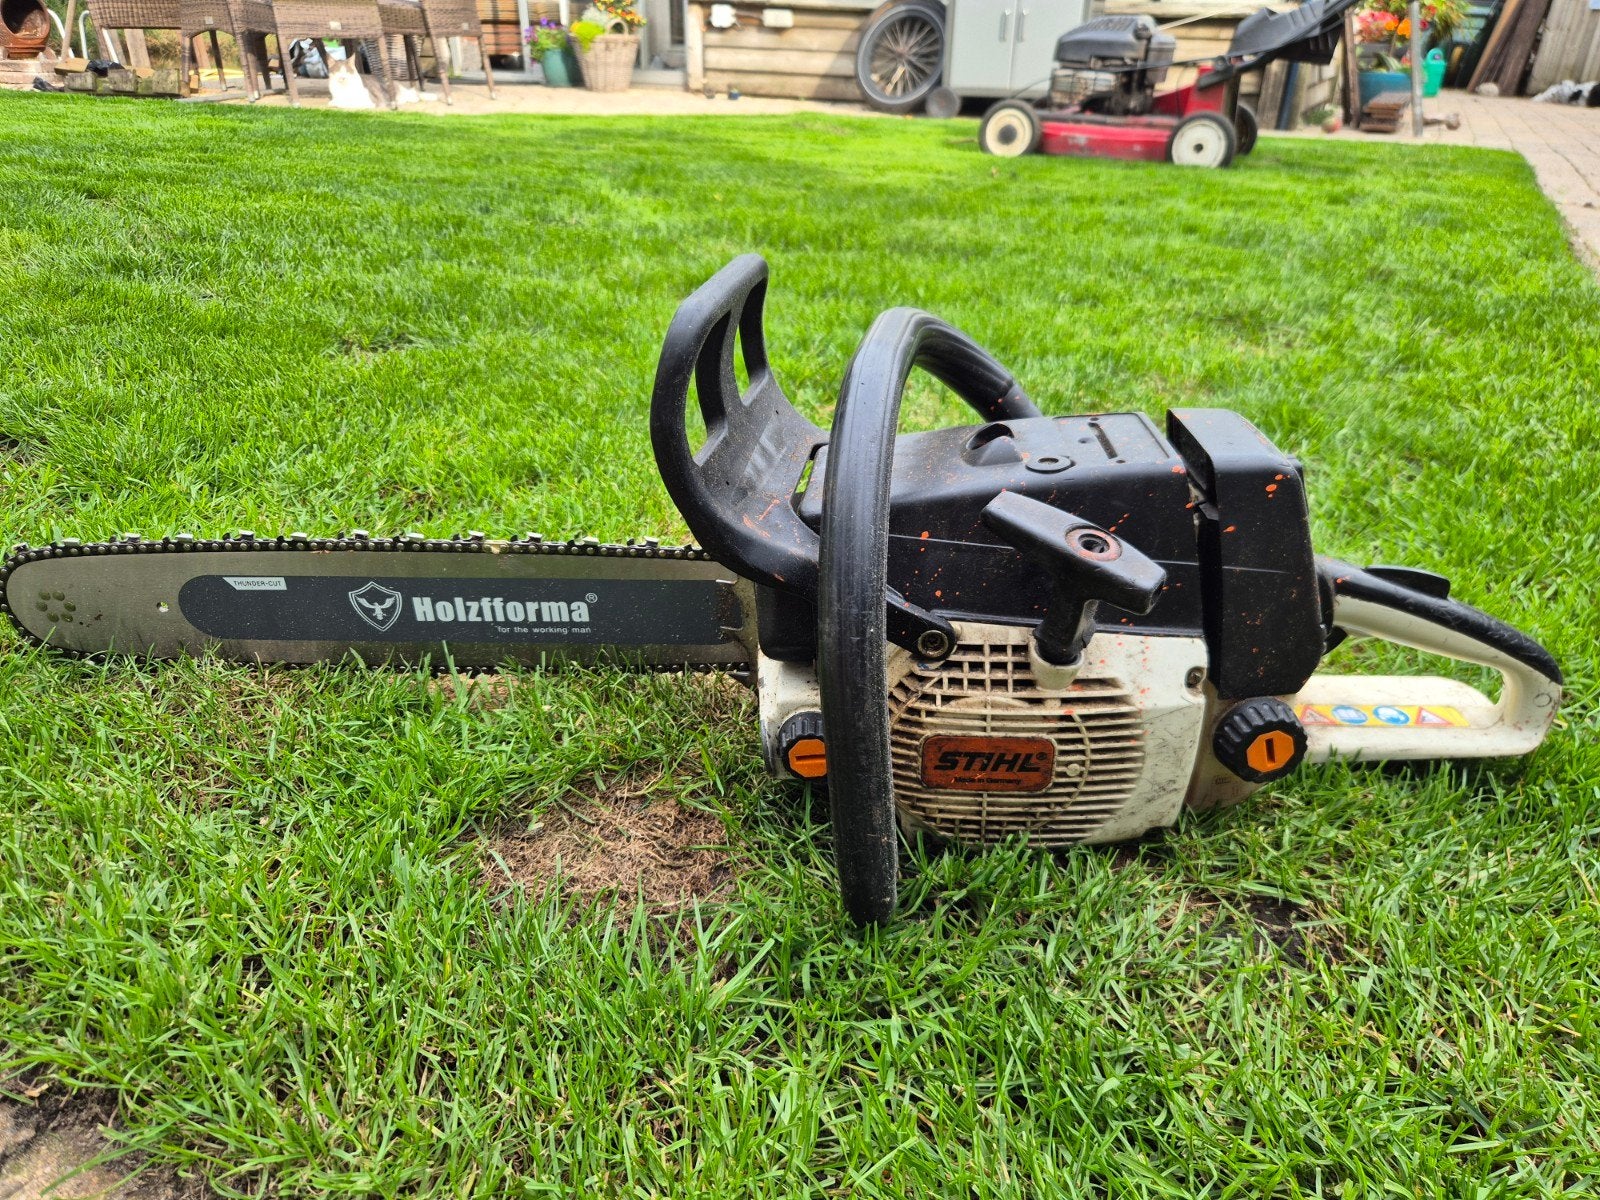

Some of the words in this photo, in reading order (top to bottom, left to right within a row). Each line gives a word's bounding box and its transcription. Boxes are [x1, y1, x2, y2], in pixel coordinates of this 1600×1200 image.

[412, 597, 590, 622] Holzfforma
[497, 625, 511, 634] for
[514, 626, 529, 634] the
[532, 626, 568, 635] working
[571, 626, 592, 634] man
[934, 751, 1041, 772] STIHL
